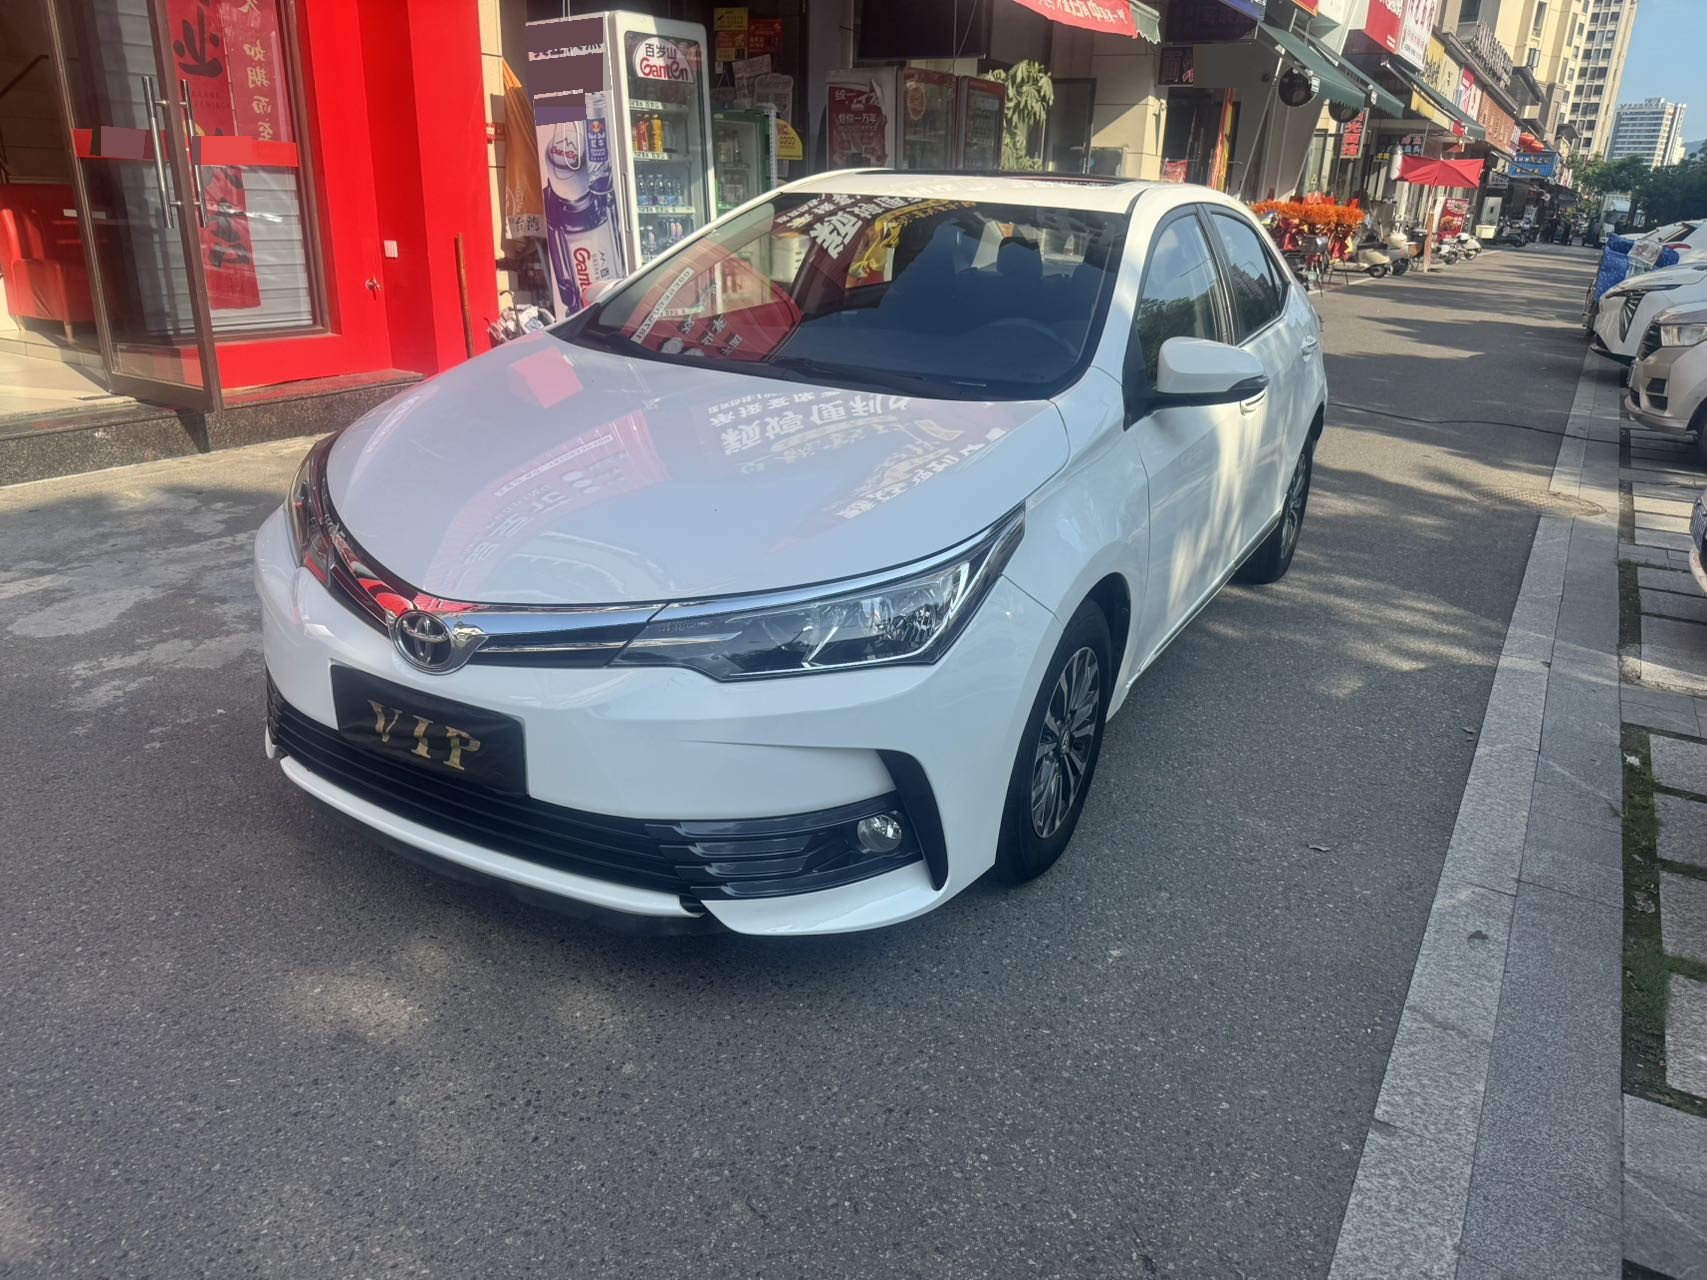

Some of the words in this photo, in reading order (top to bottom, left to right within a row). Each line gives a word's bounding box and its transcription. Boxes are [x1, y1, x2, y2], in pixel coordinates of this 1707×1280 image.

[645, 43, 677, 60] 百岁山
[639, 57, 689, 81] Ganten
[367, 699, 481, 771] VIP
